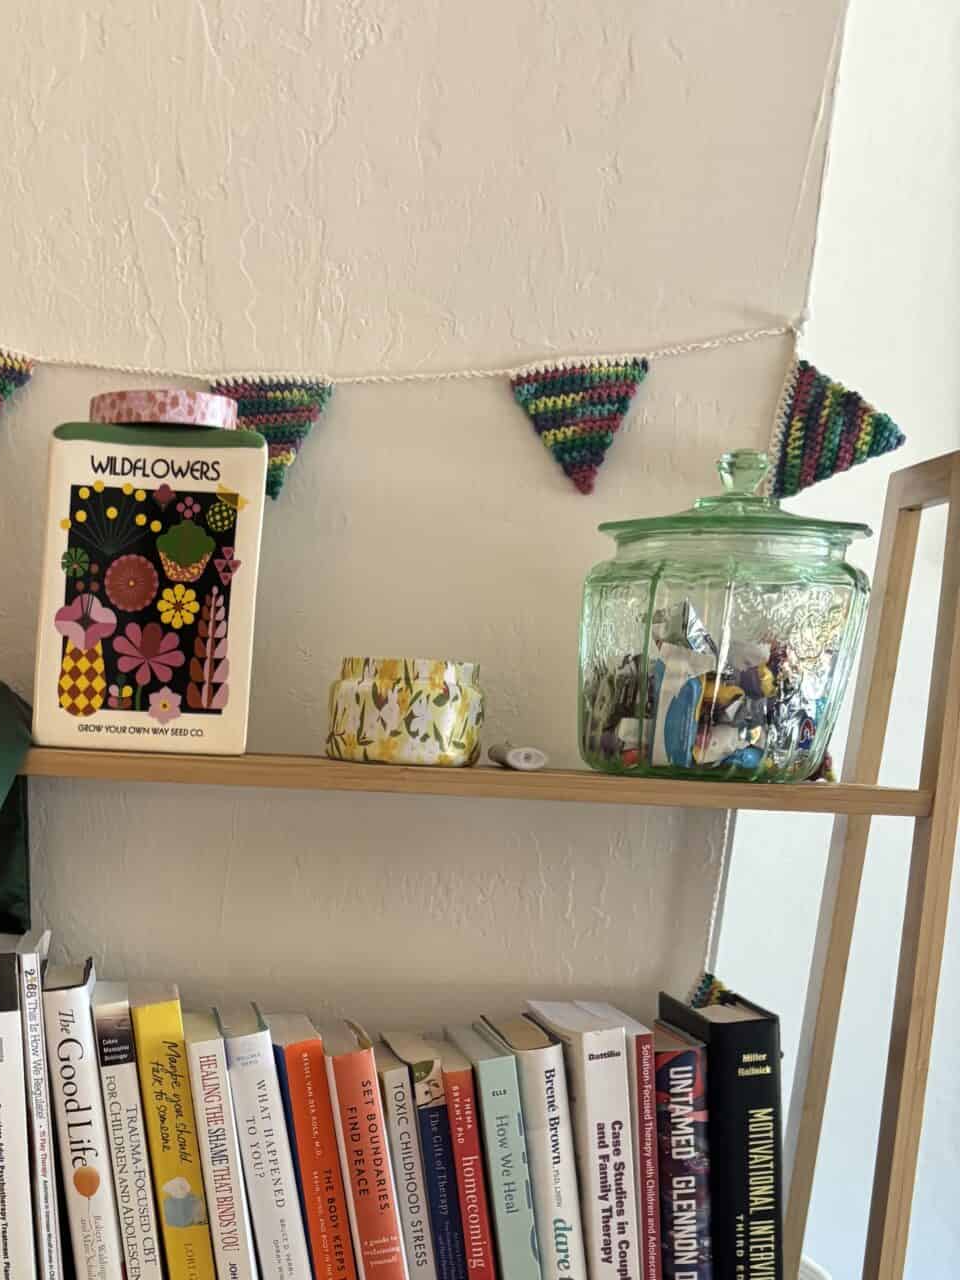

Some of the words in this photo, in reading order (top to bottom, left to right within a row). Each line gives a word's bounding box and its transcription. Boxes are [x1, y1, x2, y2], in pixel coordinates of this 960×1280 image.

[90, 454, 222, 482] WILDFLOWERS
[78, 724, 103, 733] GROW
[105, 725, 127, 734] YOUR
[128, 726, 150, 735] OWN
[151, 727, 169, 736] WAY
[170, 728, 189, 737] SEED
[58, 1009, 75, 1034] The
[56, 1038, 92, 1113] Good
[150, 1062, 163, 1087] talk
[162, 1041, 183, 1089] Maybe
[199, 1054, 221, 1103] HEALING
[642, 1044, 656, 1120] Solution-Focused
[106, 1076, 117, 1099] FOR
[154, 1091, 166, 1101] to
[168, 1094, 184, 1118] you
[256, 1080, 272, 1121] WHAT
[361, 1081, 375, 1106] SET
[393, 1082, 409, 1126] TOXIC
[544, 1068, 560, 1113] Brené
[157, 1105, 170, 1152] someone
[207, 1105, 224, 1128] THE
[246, 1115, 257, 1135] TO
[346, 1106, 361, 1143] FIND
[430, 1112, 441, 1133] The
[669, 1065, 697, 1160] UNTAMED
[67, 1120, 98, 1168] Life
[110, 1101, 128, 1173] CHILDREN
[176, 1123, 192, 1163] should
[208, 1128, 230, 1167] SHAME
[432, 1135, 442, 1160] Gift
[495, 1115, 511, 1149] How
[597, 1122, 610, 1148] and
[611, 1120, 624, 1157] Case
[644, 1122, 657, 1157] Therapy
[250, 1142, 265, 1178] YOU?
[263, 1128, 286, 1209] HAPPENED
[352, 1149, 369, 1197] PEACE
[399, 1131, 421, 1216] CHILDHOOD
[436, 1160, 446, 1172] of
[501, 1152, 514, 1176] We
[597, 1154, 612, 1201] Family
[646, 1159, 657, 1177] with
[748, 1108, 775, 1214] MOTIVATIONAL
[120, 1179, 130, 1203] AND
[126, 1105, 150, 1232] TRAUMA-FOCUSED
[143, 1237, 157, 1265] CBT
[213, 1166, 234, 1195] THAT
[324, 1169, 333, 1192] THE
[438, 1173, 450, 1216] Therapy
[504, 1180, 520, 1214] Heal
[614, 1161, 628, 1217] Studies
[647, 1180, 658, 1215] Children
[216, 1196, 237, 1228] BINDS
[327, 1197, 338, 1229] BODY
[462, 1155, 487, 1269] homecoming
[617, 1222, 630, 1235] in
[647, 1218, 656, 1234] and
[672, 1176, 699, 1264] GLENNON
[1, 1222, 11, 1260] Treatment
[220, 1229, 240, 1252] YOU
[410, 1220, 428, 1267] STRESS
[553, 1218, 573, 1271] dare
[600, 1205, 614, 1264] Therapy
[332, 1235, 345, 1272] KEEPS
